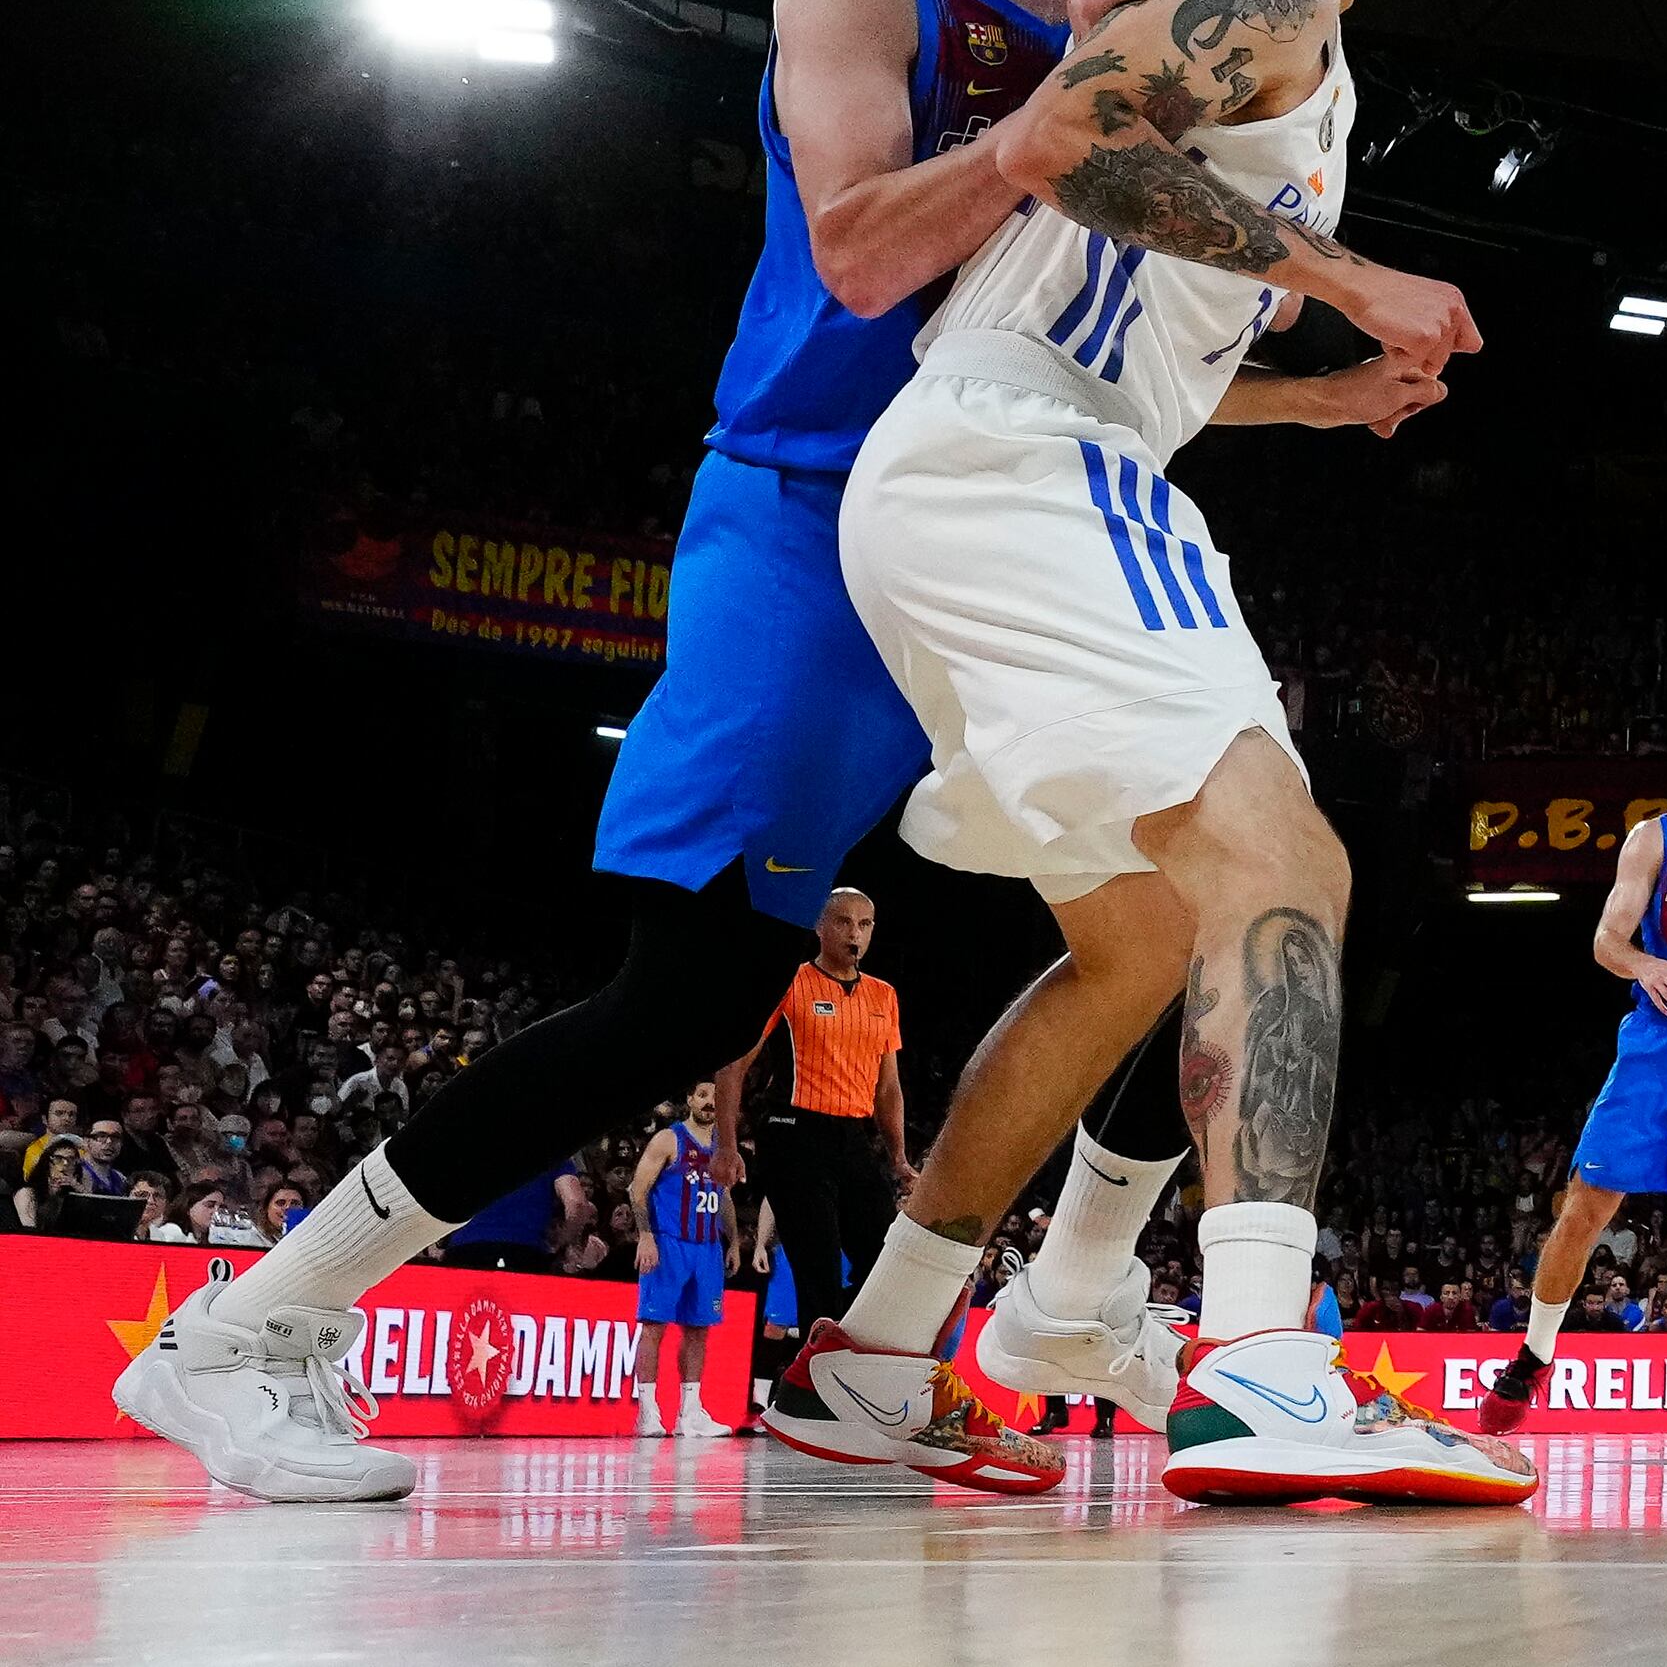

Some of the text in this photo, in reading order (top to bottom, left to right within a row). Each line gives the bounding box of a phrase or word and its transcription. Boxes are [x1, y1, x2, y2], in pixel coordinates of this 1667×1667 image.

[429, 530, 597, 610] SEMPRE
[432, 607, 470, 636] Des
[515, 622, 575, 651] 1997
[695, 1191, 719, 1214] 20
[507, 1313, 644, 1398] DAMM
